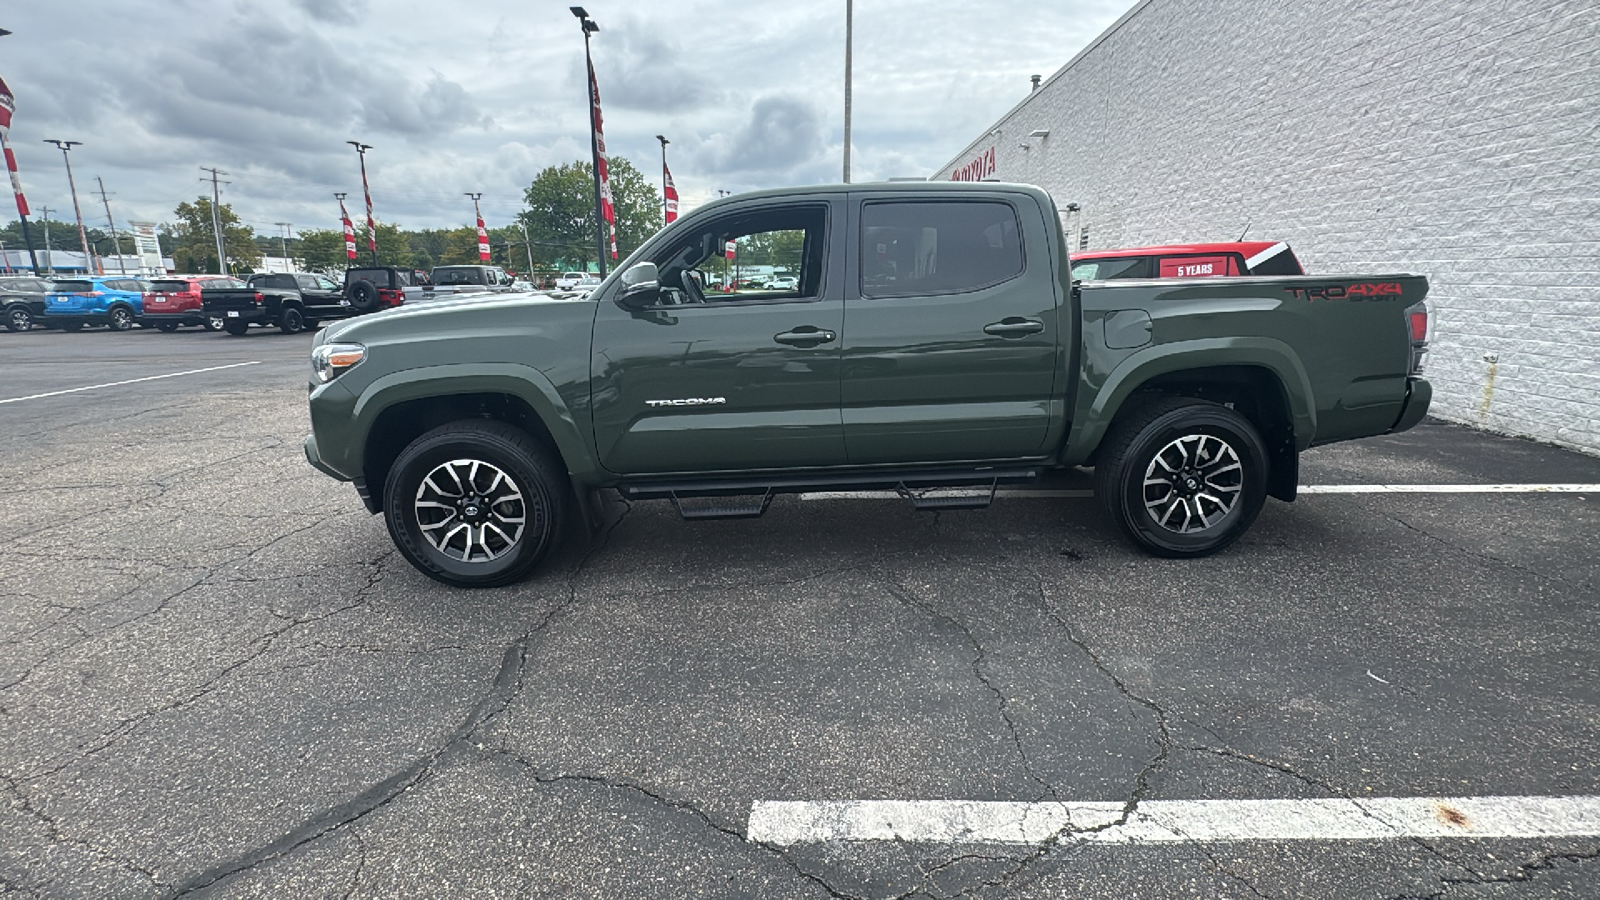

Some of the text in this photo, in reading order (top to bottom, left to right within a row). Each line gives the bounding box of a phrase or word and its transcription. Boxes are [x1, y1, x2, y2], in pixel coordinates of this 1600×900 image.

[961, 146, 995, 182] TOYOTA
[1177, 263, 1213, 277] 5 YEARS
[645, 396, 727, 408] TACOMA
